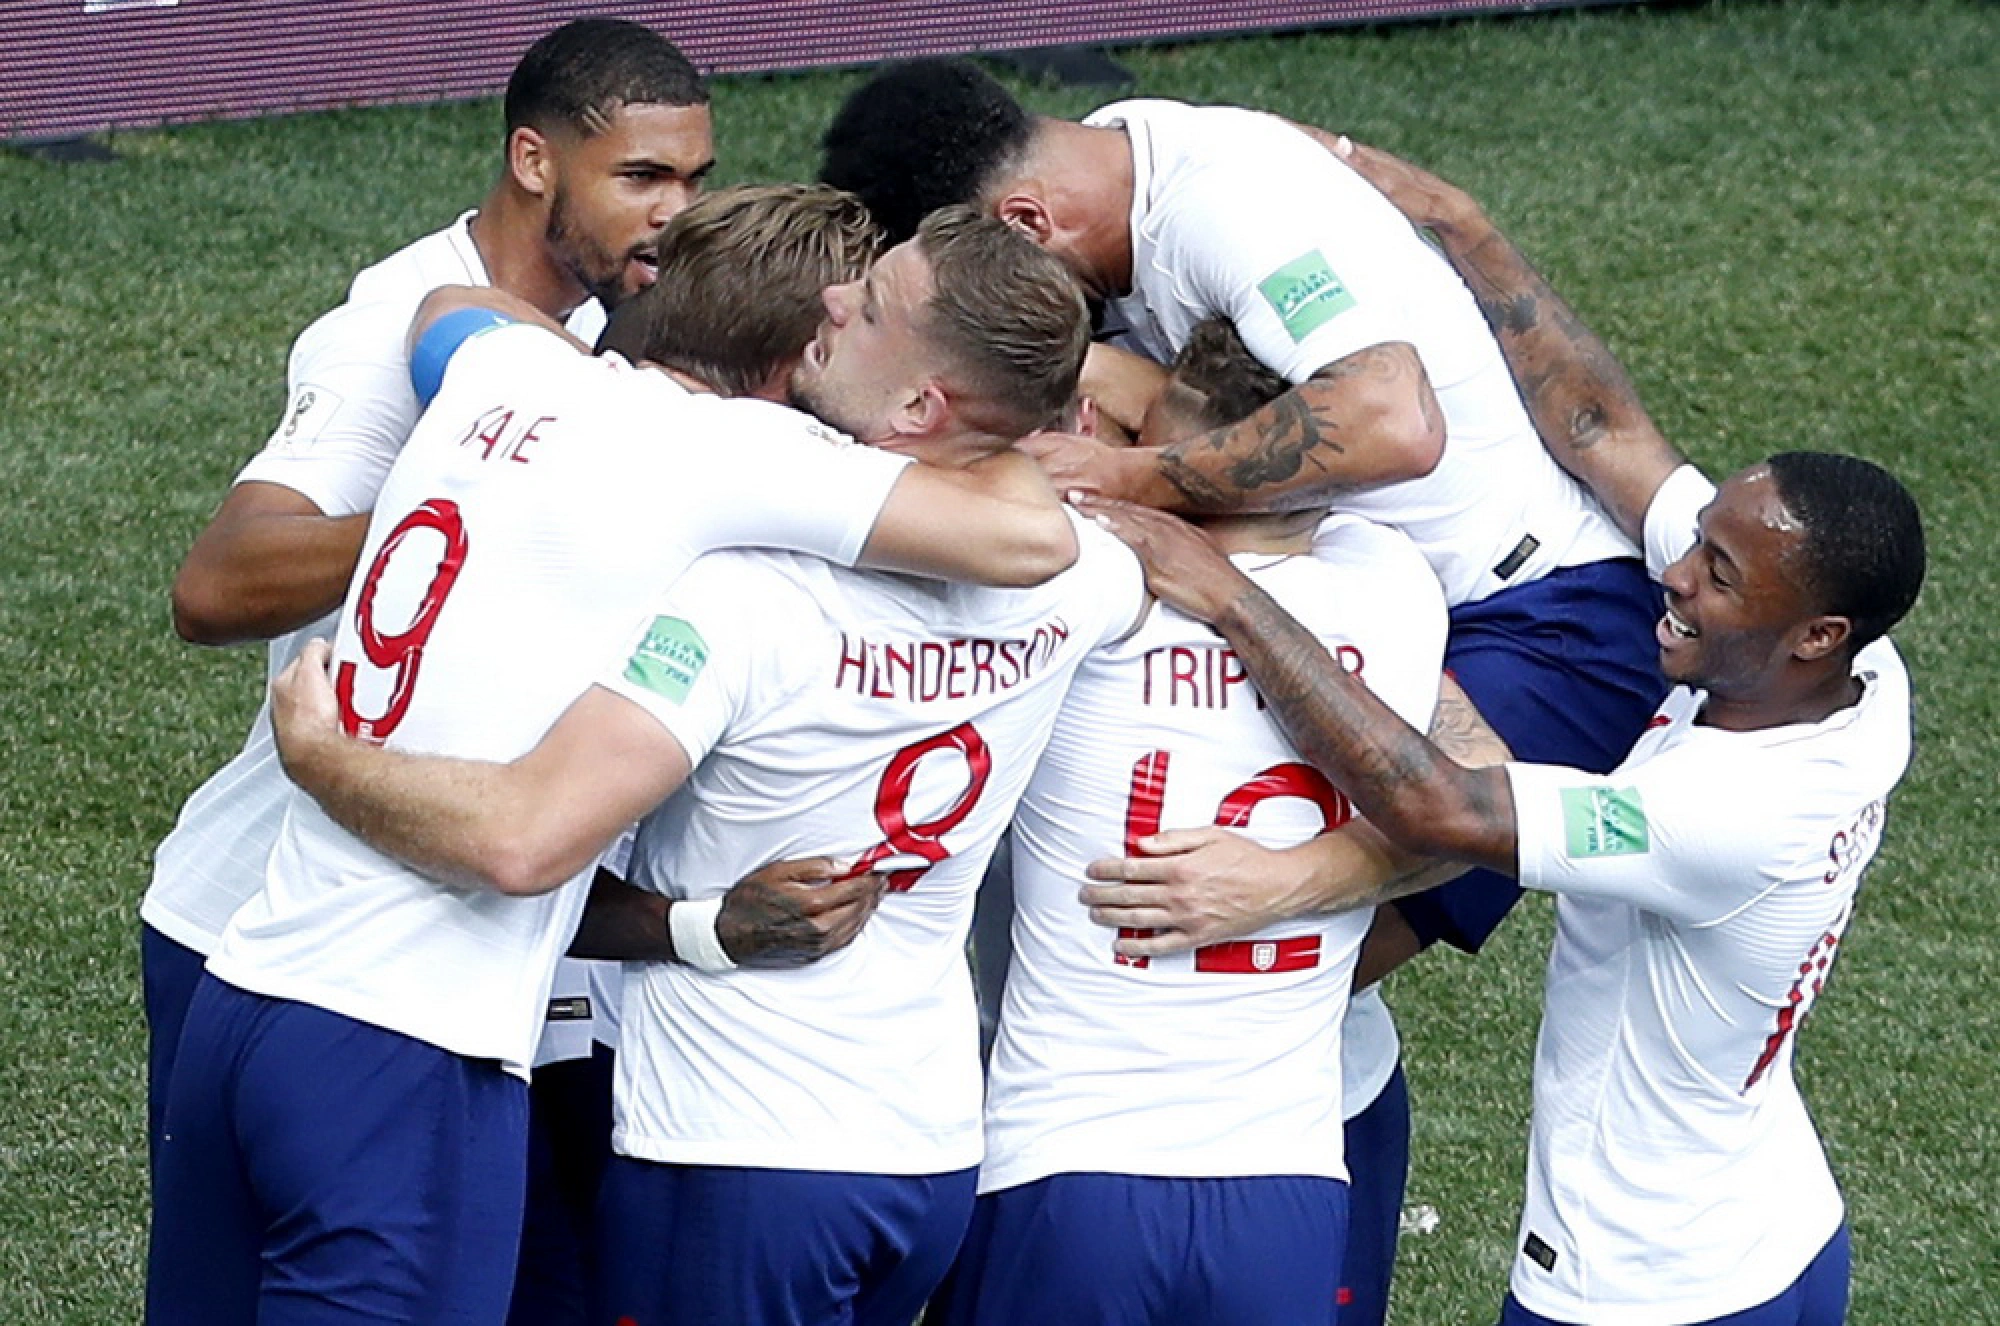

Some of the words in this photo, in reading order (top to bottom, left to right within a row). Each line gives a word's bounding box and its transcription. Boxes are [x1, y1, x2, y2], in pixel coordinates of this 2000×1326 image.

[336, 498, 468, 747] 9
[835, 616, 1069, 703] HENDERSON
[1142, 645, 1367, 710] TRIPR
[832, 721, 993, 892] 8
